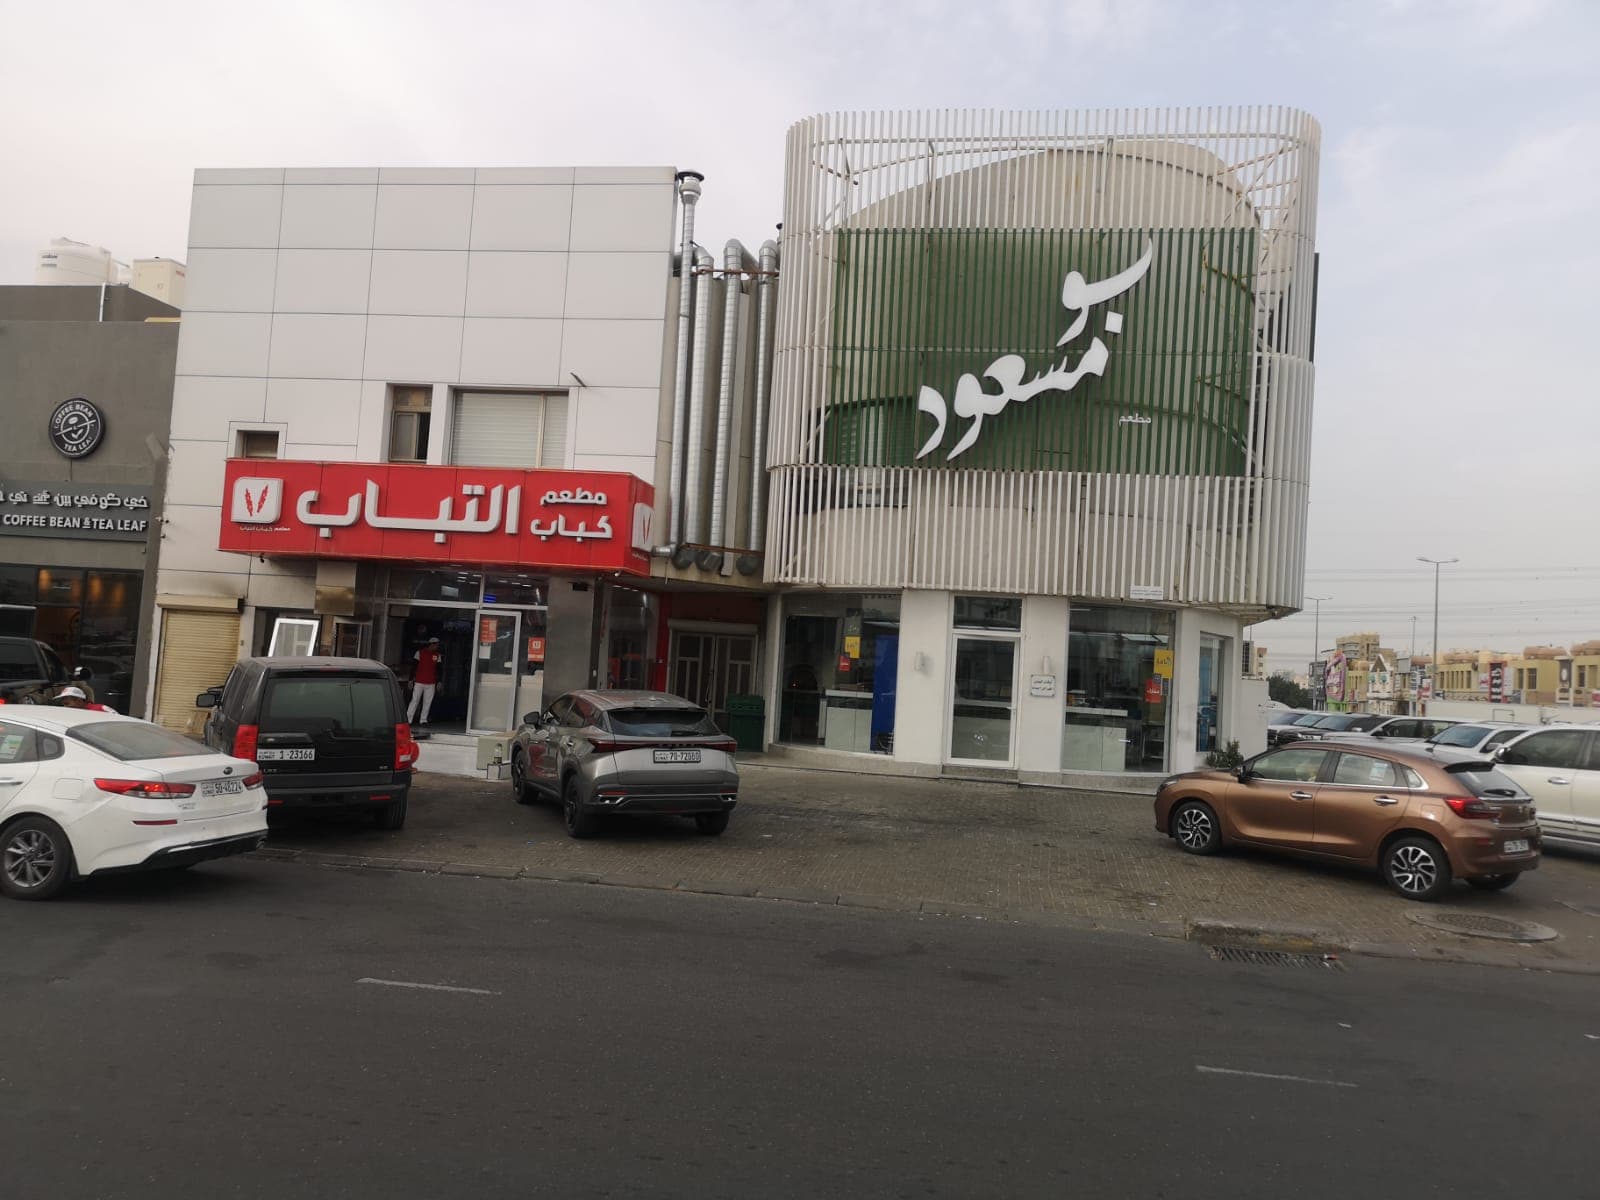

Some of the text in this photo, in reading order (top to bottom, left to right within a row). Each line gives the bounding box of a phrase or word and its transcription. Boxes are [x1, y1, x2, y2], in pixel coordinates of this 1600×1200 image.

[1057, 237, 1153, 347] بو
[915, 336, 1109, 461] مسعود
[1119, 413, 1152, 427] مطعم
[540, 487, 607, 506] مطعم
[3, 513, 147, 532] COFFEE BEAN & TEA LEAF
[530, 513, 613, 542] كباب
